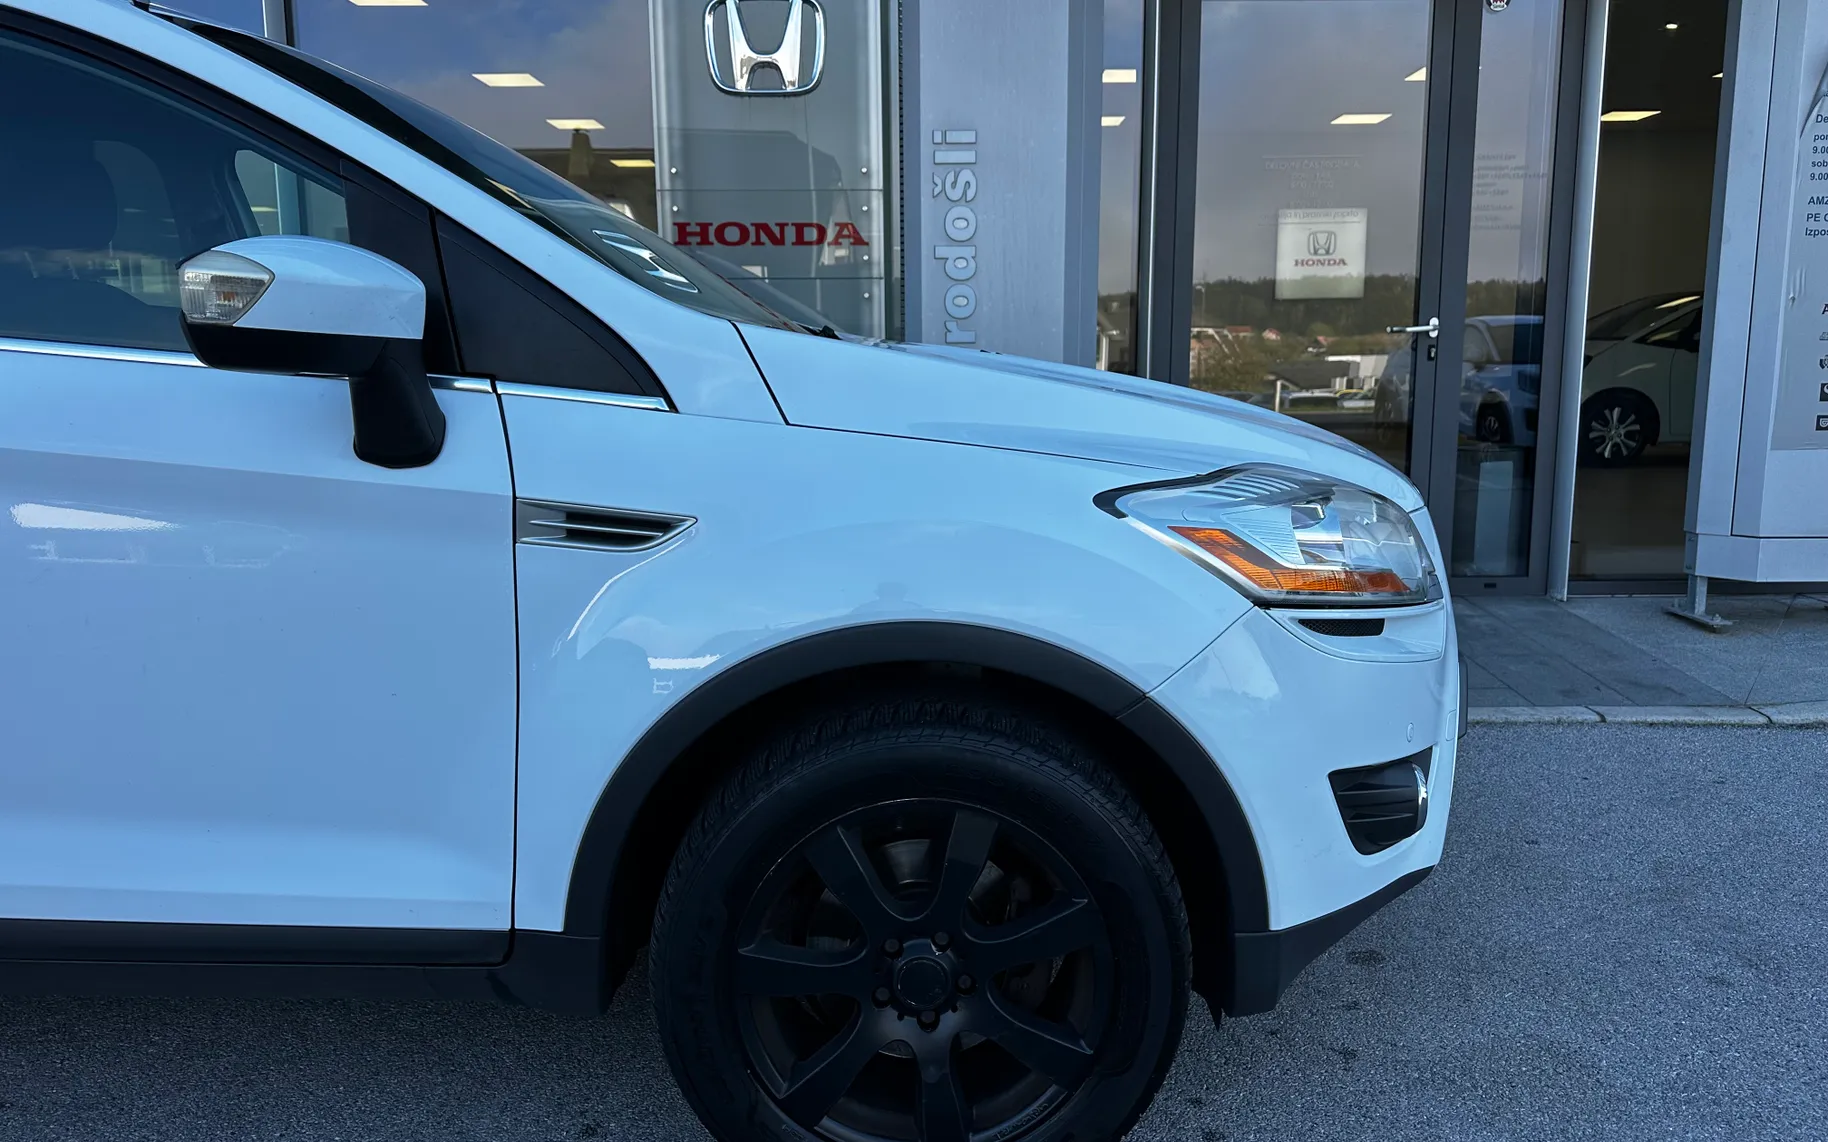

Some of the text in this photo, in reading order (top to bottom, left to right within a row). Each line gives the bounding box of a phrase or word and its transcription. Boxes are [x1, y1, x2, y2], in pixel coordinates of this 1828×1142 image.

[1806, 213, 1821, 222] PE
[673, 222, 869, 246] HONDA
[1805, 227, 1828, 238] Izpo
[1294, 258, 1348, 268] HONDA
